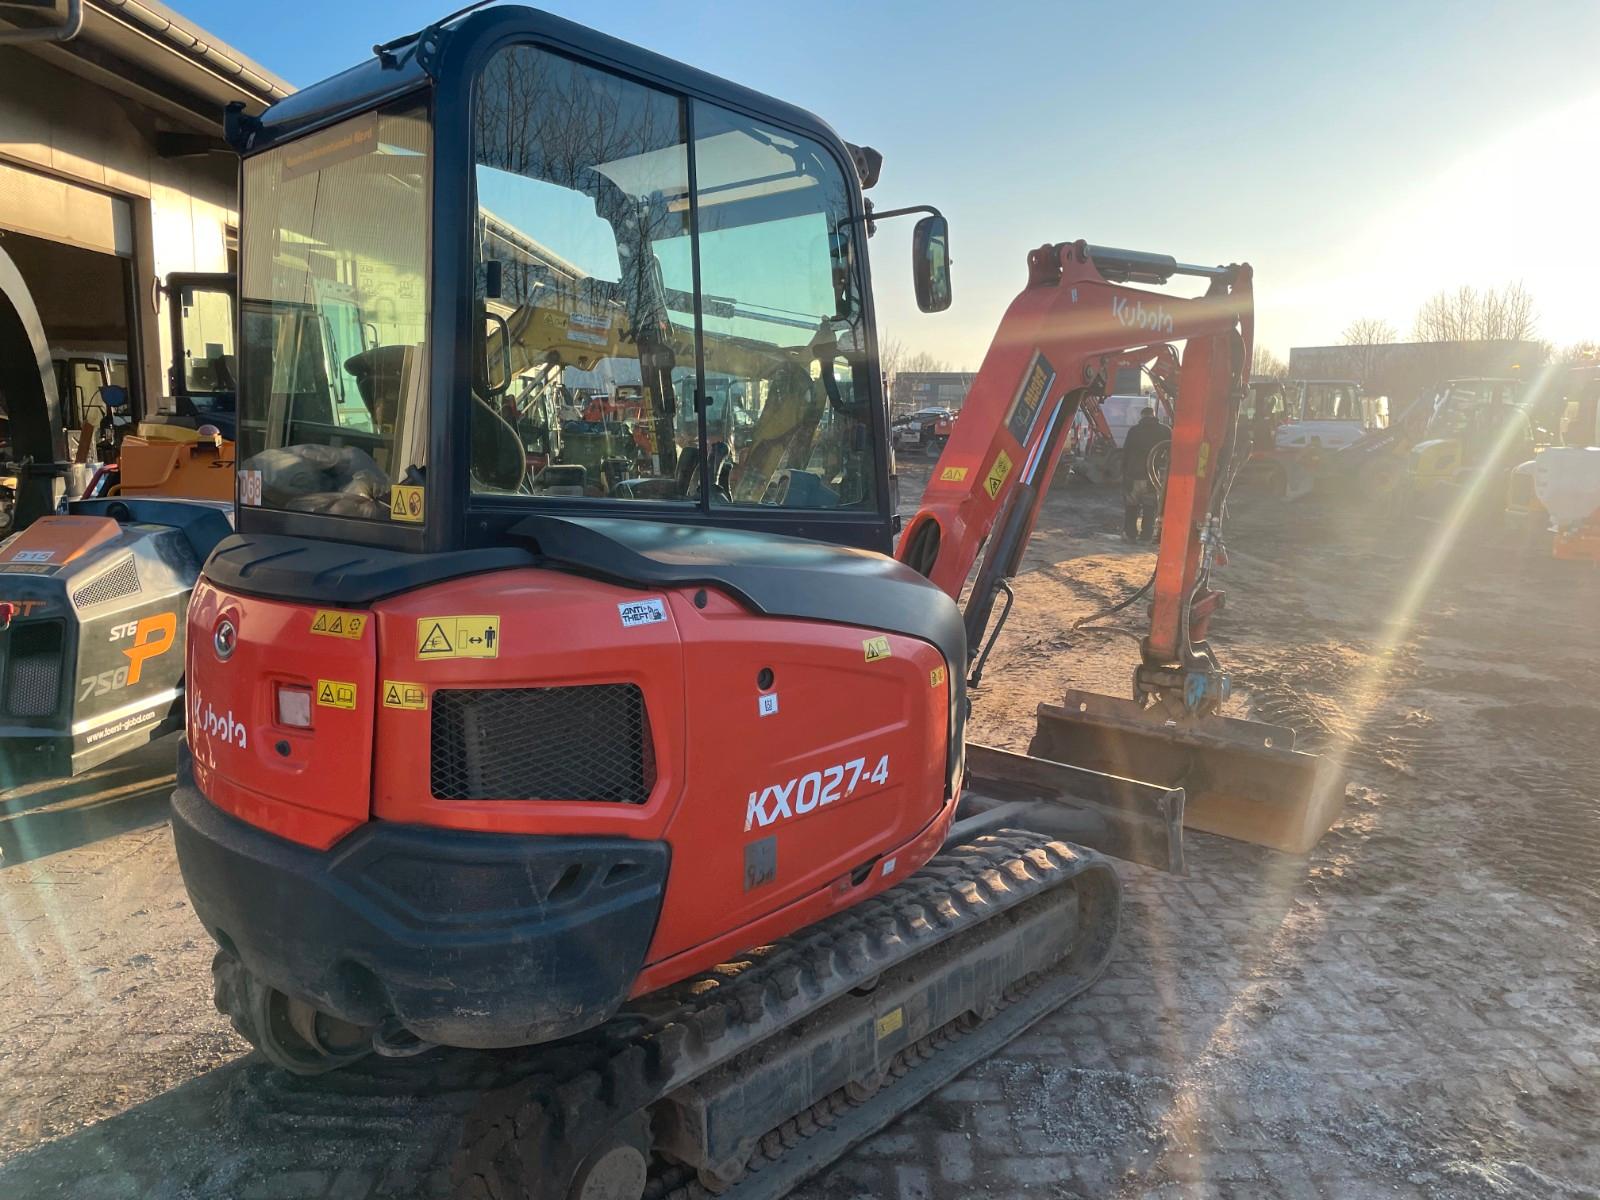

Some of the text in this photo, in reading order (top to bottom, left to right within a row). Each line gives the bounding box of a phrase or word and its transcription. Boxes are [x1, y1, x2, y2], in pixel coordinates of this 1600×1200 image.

[1112, 295, 1174, 335] Kubota
[622, 612, 649, 622] THEFT
[78, 665, 129, 703] 750
[193, 695, 247, 749] Kubota
[743, 754, 889, 833] KX027-4
